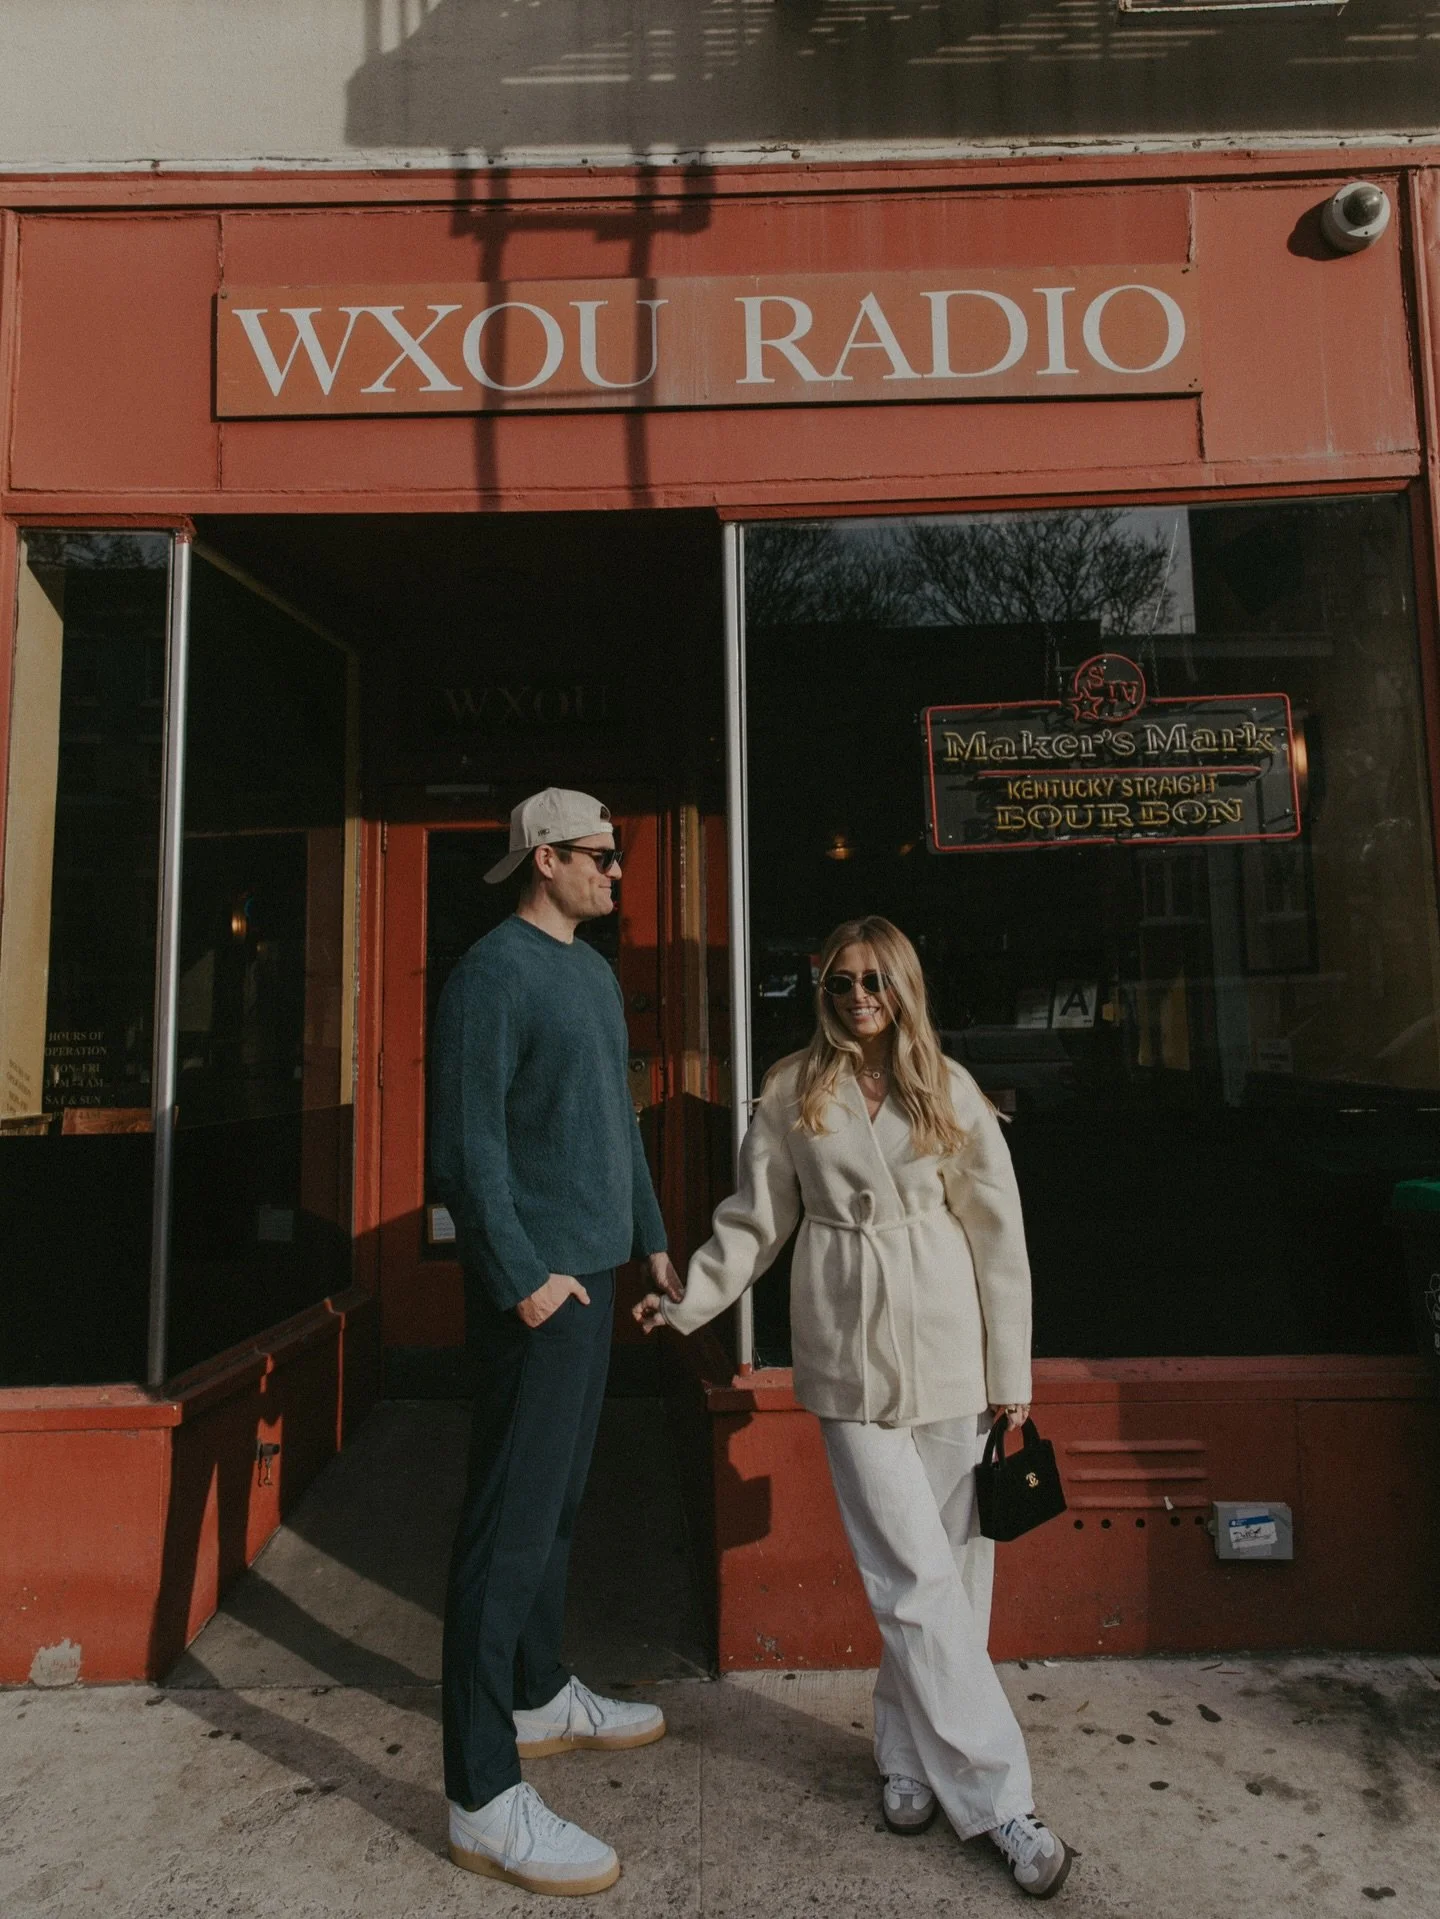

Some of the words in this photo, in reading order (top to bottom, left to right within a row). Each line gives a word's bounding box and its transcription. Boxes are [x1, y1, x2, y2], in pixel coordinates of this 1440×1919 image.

[231, 298, 670, 397] WXOU
[734, 283, 1187, 385] RADIO
[445, 686, 608, 718] WXOU
[943, 728, 1137, 764] Maker's
[1143, 721, 1276, 757] Mark
[1007, 777, 1115, 800] KENTUCKY
[1121, 773, 1218, 798] STRAIGHT
[995, 798, 1244, 832] BOURBON
[1060, 984, 1090, 1017] A
[45, 1046, 107, 1057] OPERATION
[49, 1031, 87, 1042] HOURS
[88, 1031, 105, 1041] OF
[44, 1095, 66, 1105] SAT
[79, 1095, 101, 1105] SUN
